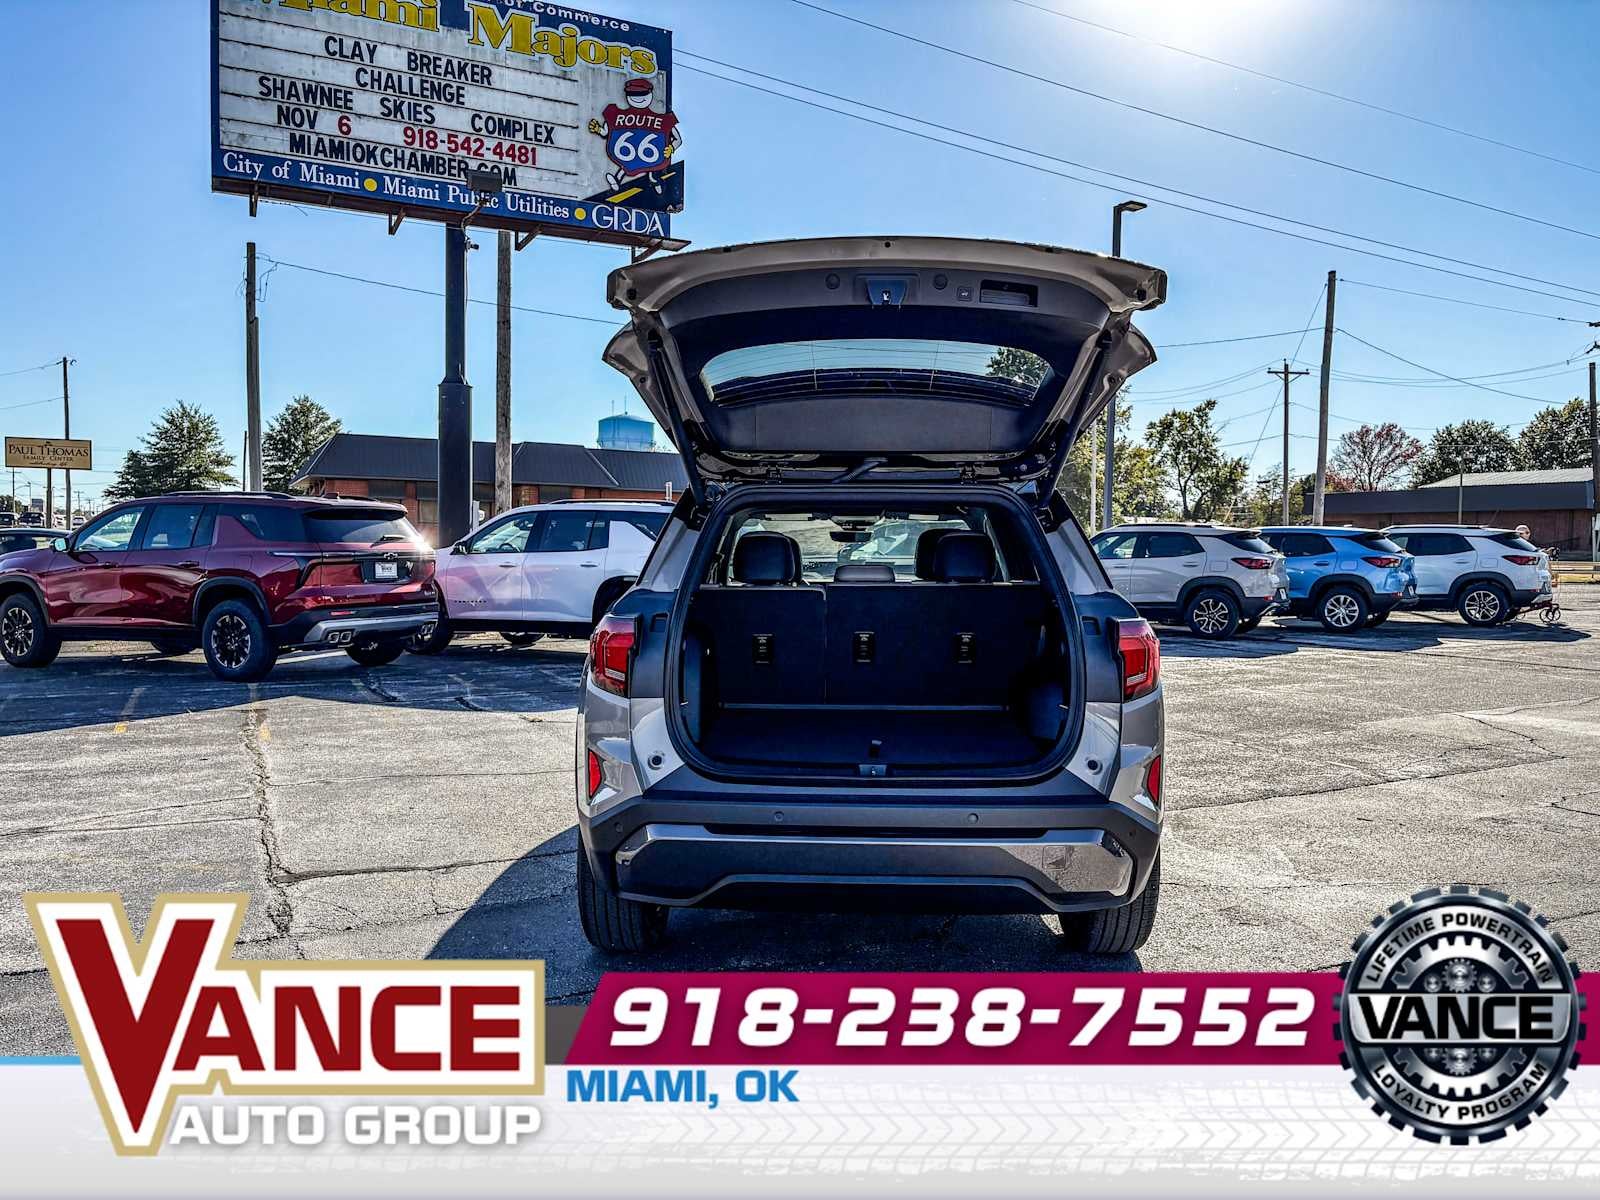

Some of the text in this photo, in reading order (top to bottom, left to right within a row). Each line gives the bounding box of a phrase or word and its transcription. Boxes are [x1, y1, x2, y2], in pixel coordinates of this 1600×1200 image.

[262, 0, 656, 74] ami Majors
[533, 2, 630, 32] Commerce
[324, 36, 492, 85] CLAY BREAKER
[258, 76, 555, 145] SHAWNEE SKIES COMPLEX
[355, 68, 465, 105] CHALLENGE
[277, 105, 537, 166] NOV 6 918-542-4481
[615, 114, 662, 129] ROUTE
[290, 133, 517, 186] MIAMIOKCHAMBERM
[614, 132, 659, 162] 66
[223, 152, 264, 180] City
[272, 161, 291, 179] of
[300, 163, 360, 189] Miami
[383, 176, 440, 201] Miami
[506, 192, 569, 218] Utilities
[591, 205, 664, 236] GRDA
[9, 444, 88, 456] PAUL THOMAS
